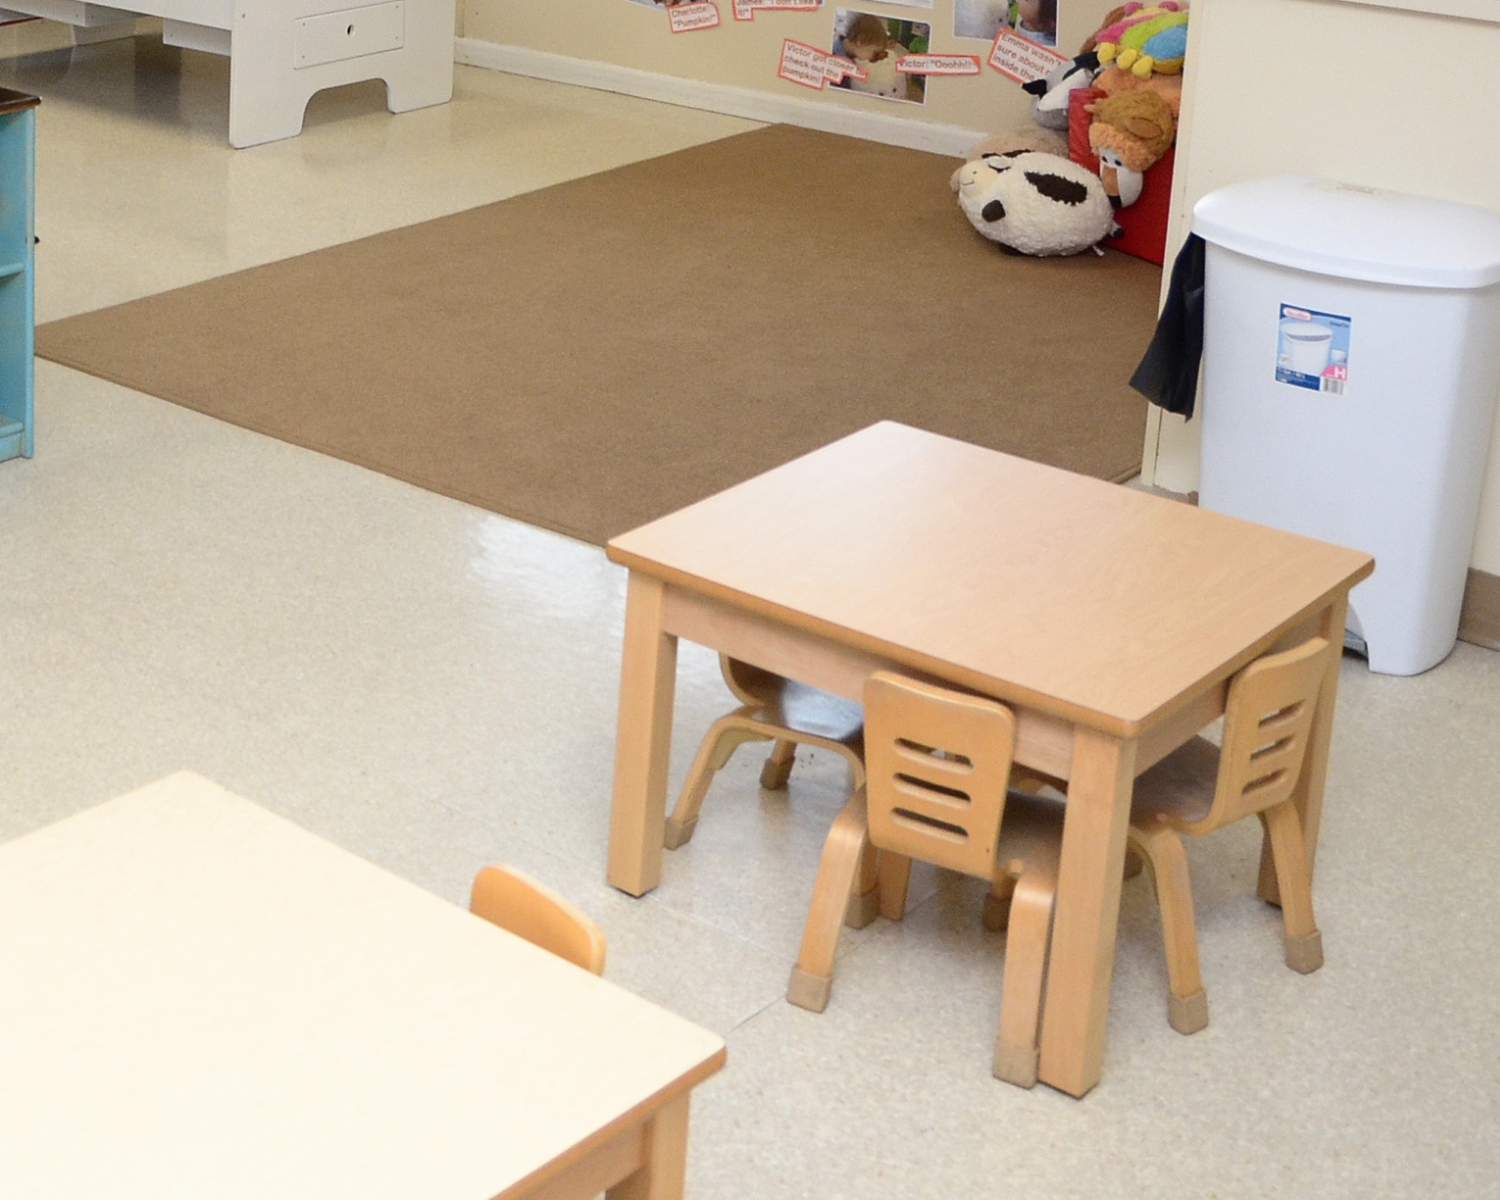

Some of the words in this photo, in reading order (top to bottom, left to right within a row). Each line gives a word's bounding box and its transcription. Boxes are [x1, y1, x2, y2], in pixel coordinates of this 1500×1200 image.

[787, 44, 812, 57] Victor
[1002, 32, 1030, 53] Emma
[784, 56, 808, 68] check
[811, 64, 824, 74] out
[826, 68, 839, 78] the
[992, 56, 1018, 72] inside
[1020, 68, 1034, 80] the
[997, 45, 1016, 58] sure
[1018, 56, 1044, 73] about
